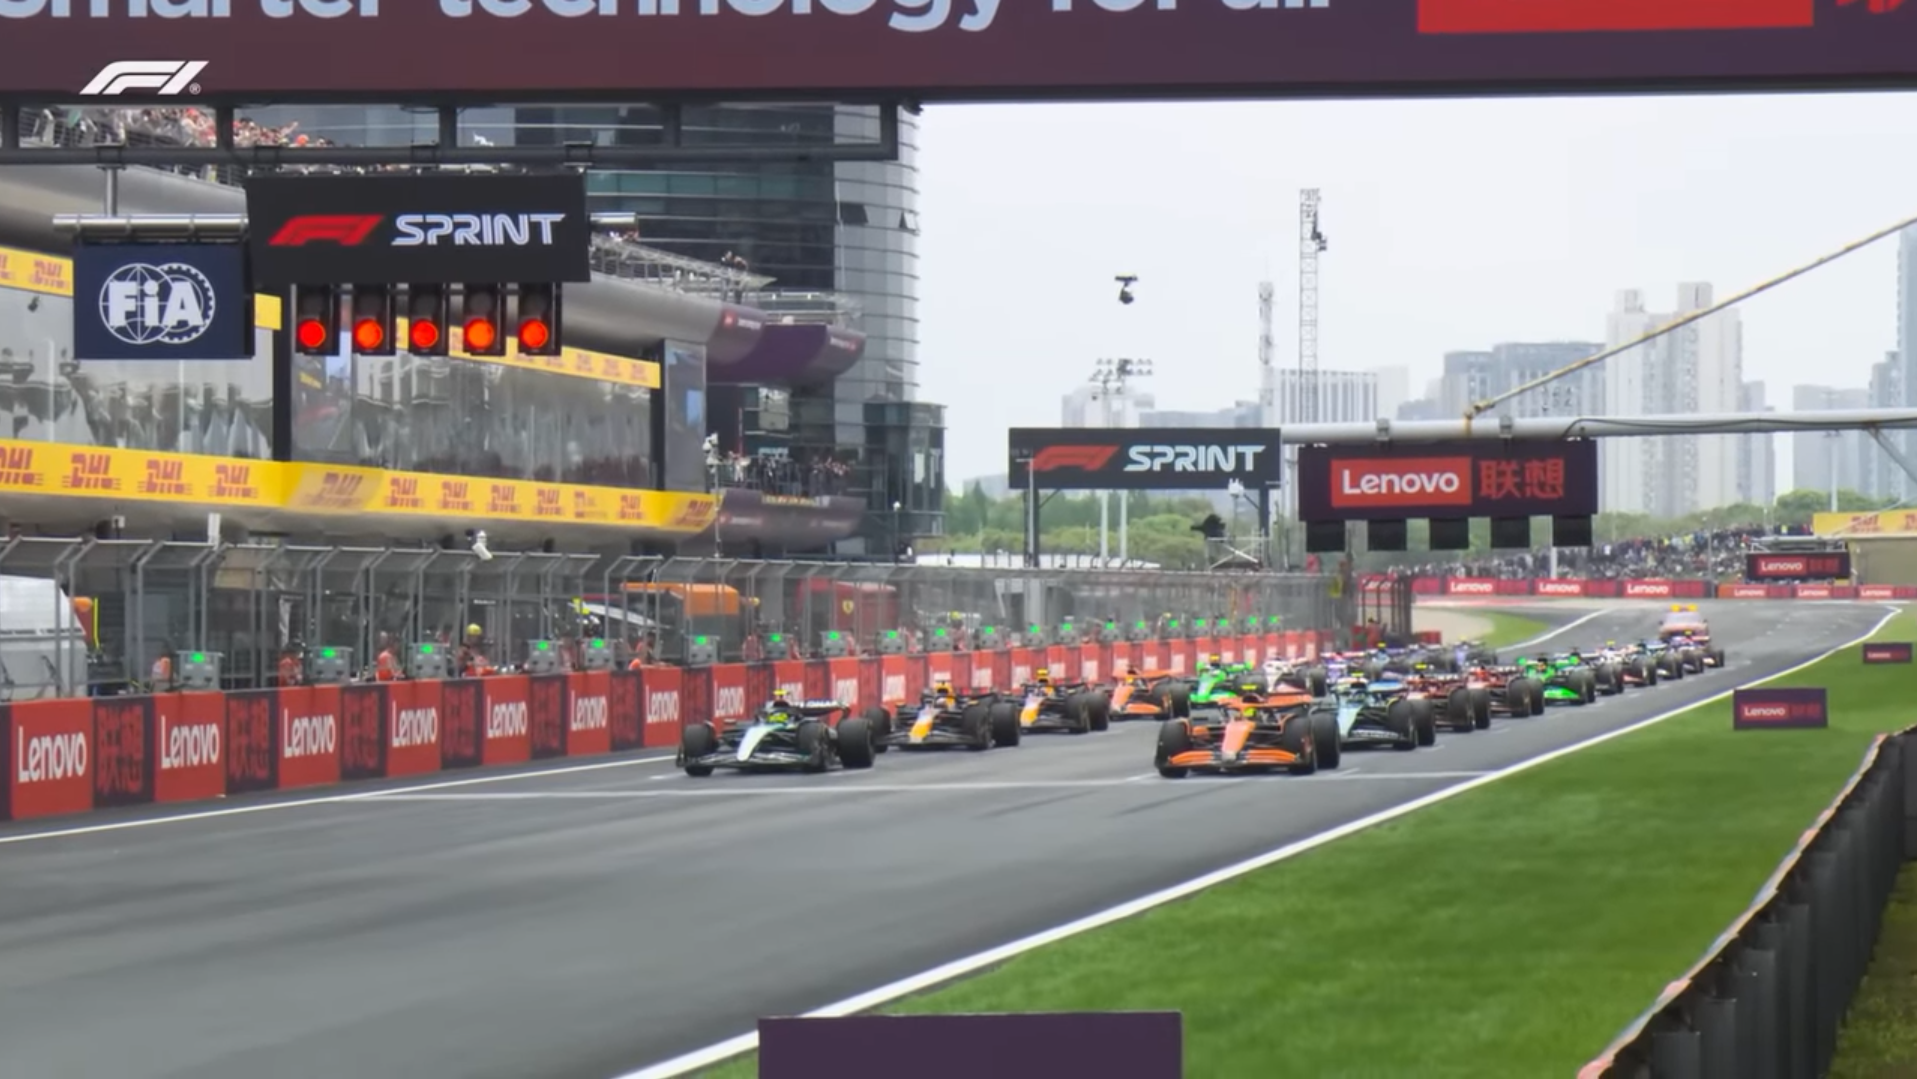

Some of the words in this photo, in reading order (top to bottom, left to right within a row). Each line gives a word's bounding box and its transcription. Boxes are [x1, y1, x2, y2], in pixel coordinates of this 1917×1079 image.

[391, 213, 566, 246] SPRINT
[1123, 445, 1266, 472] SPRINT
[1343, 470, 1460, 494] Lenovo
[1479, 457, 1564, 498] 联想
[392, 700, 438, 748] Lenovo
[486, 695, 528, 738] Lenovo
[570, 690, 608, 731] Lenovo
[161, 715, 220, 769] Lenovo
[284, 707, 336, 758] Lenovo
[18, 726, 87, 783] Lenovo
